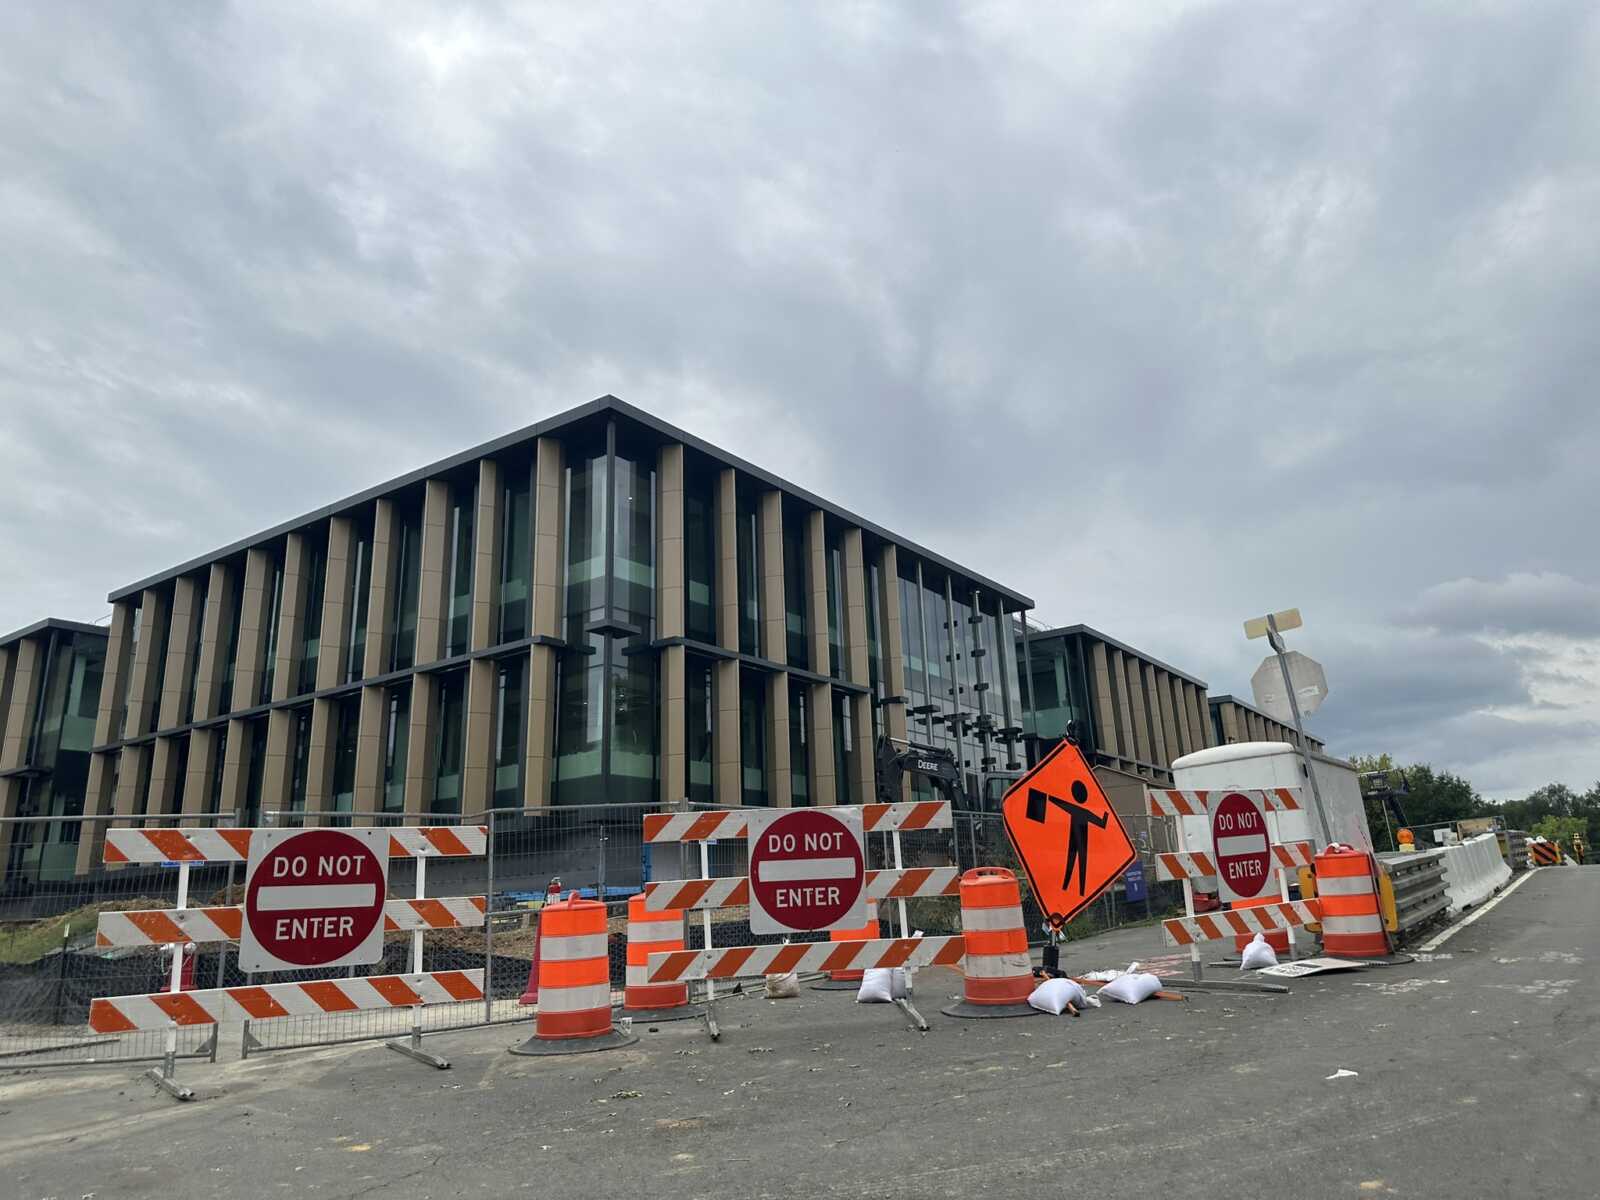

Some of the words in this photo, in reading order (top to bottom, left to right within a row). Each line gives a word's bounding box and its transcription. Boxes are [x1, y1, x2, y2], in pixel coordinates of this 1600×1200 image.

[917, 759, 939, 771] DEERE
[1218, 814, 1234, 831] DO
[1237, 812, 1257, 829] NOT
[768, 833, 796, 853] DO
[804, 832, 844, 852] NOT
[273, 855, 308, 878] DO
[318, 855, 366, 877] NOT
[1228, 859, 1263, 880] ENTER
[775, 886, 841, 908] ENTER
[275, 916, 354, 941] ENTER
